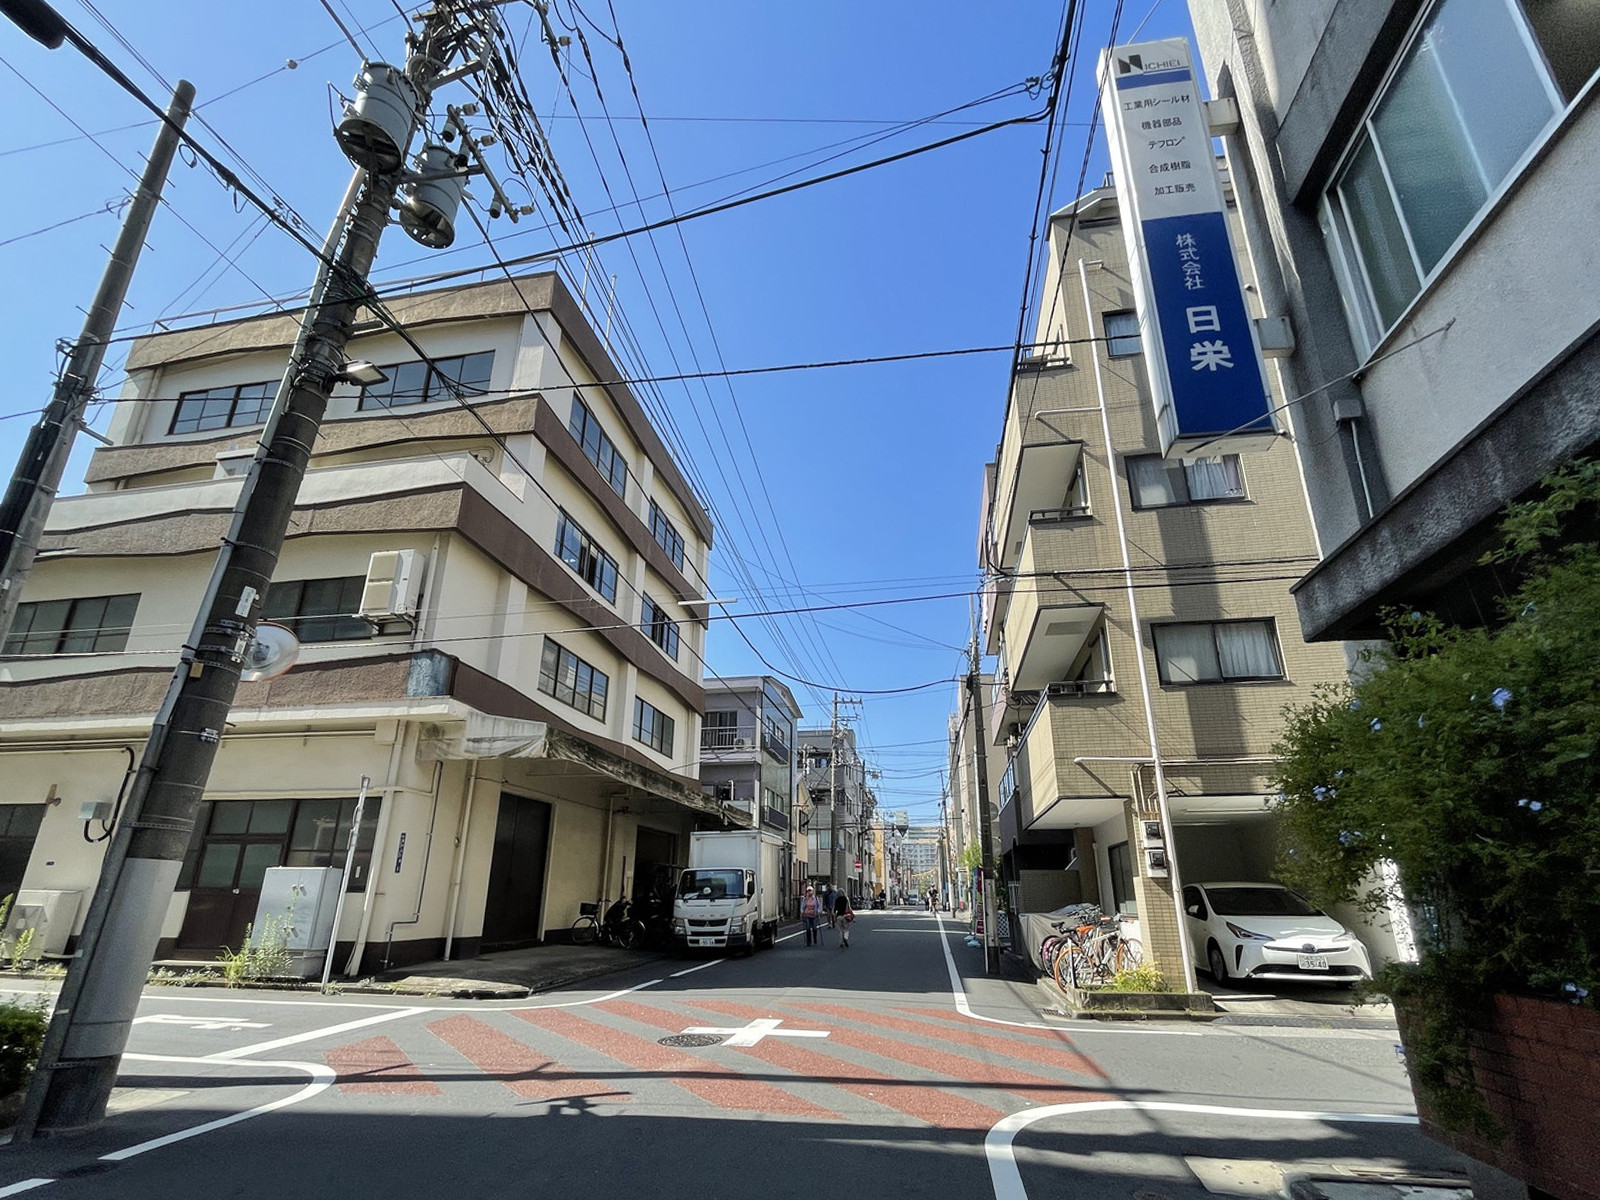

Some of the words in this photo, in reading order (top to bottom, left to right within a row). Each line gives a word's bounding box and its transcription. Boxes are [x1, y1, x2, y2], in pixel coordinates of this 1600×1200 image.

[1124, 94, 1190, 111] 工業用シール材
[1141, 117, 1182, 130] 機器部品
[1149, 160, 1191, 174] 合成樹脂
[1154, 183, 1196, 196] 加工販売
[1176, 233, 1205, 290] 株式会社
[1186, 305, 1234, 372] 日栄
